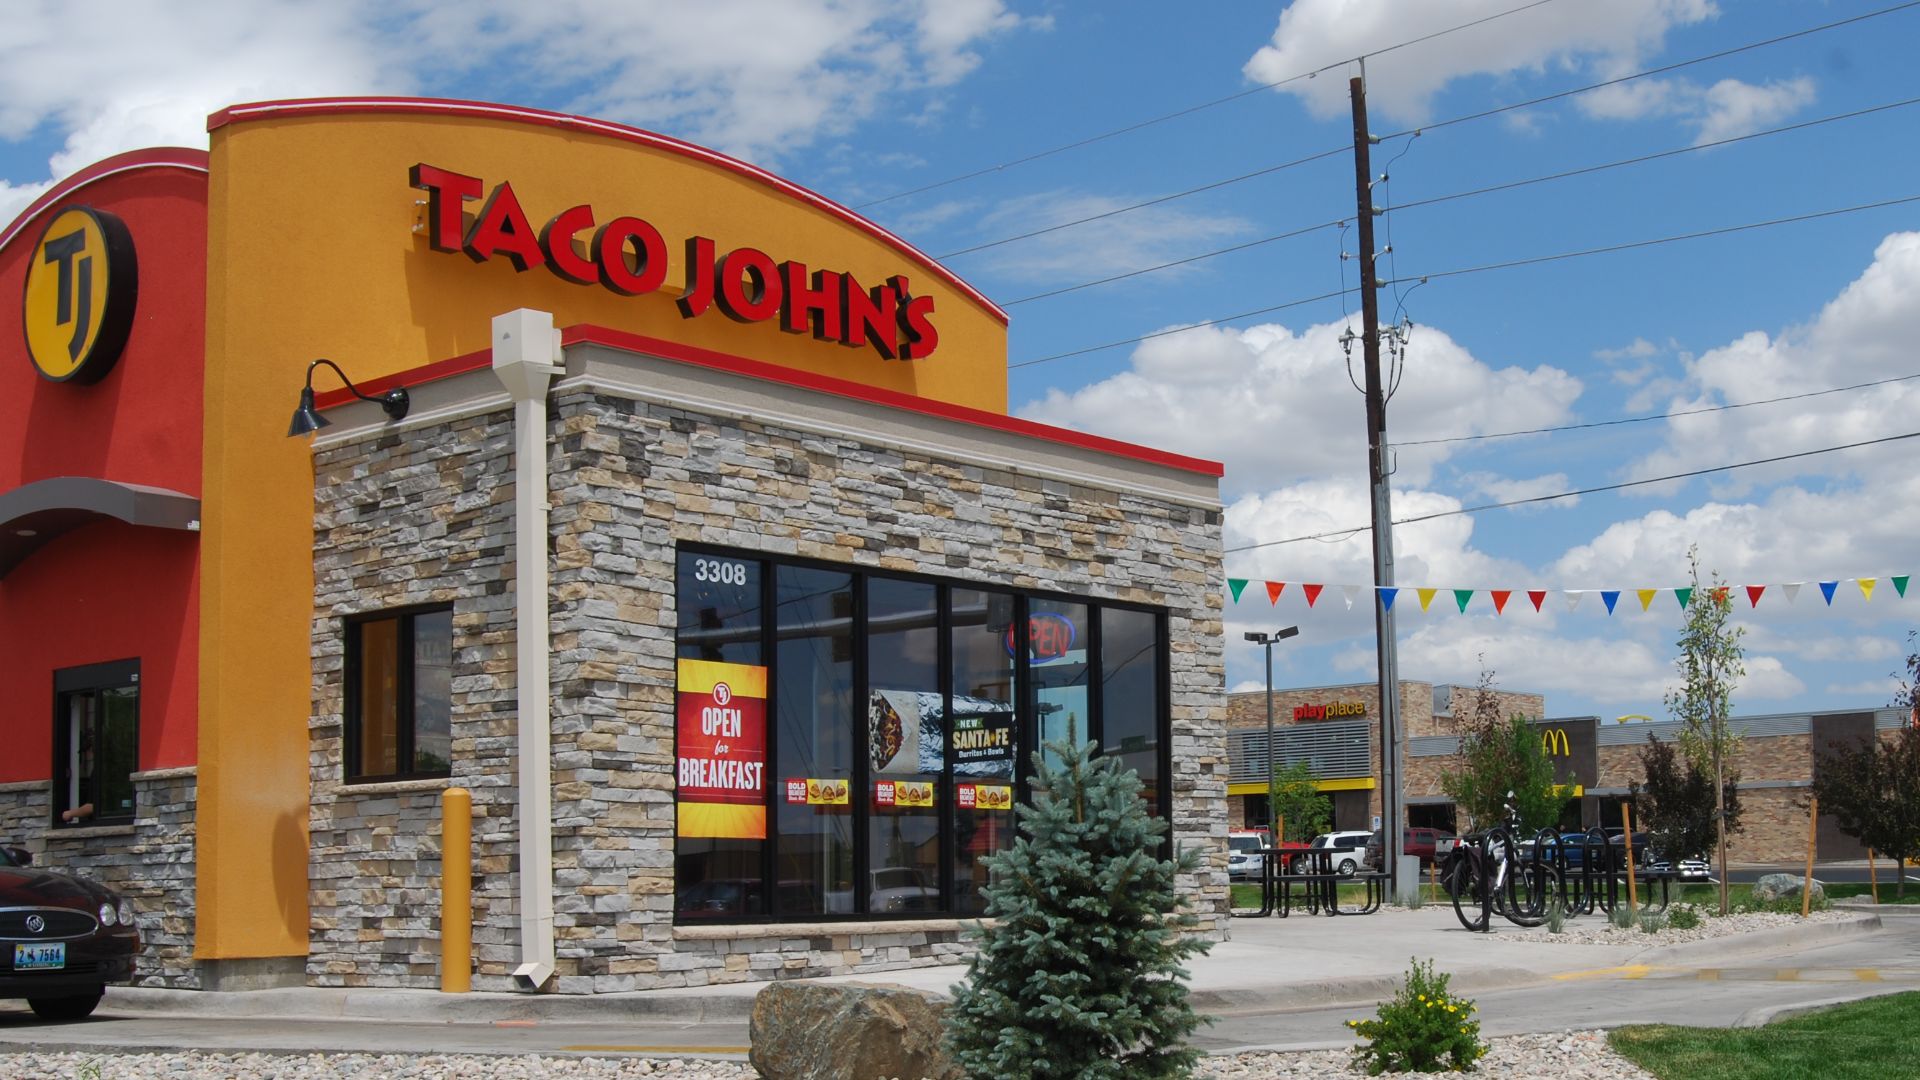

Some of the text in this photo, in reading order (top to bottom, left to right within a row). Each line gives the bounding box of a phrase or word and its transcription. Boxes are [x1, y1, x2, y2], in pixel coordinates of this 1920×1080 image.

[409, 163, 939, 361] TACO JOHN'S
[44, 227, 92, 364] TJ
[695, 558, 746, 586] 3308
[702, 707, 742, 738] OPEN
[1293, 701, 1364, 720] playplace
[960, 719, 978, 729] NEW
[715, 740, 729, 756] for
[953, 727, 1009, 749] SANTA FE
[679, 757, 763, 790] BREAKFAST
[19, 950, 25, 962] 2
